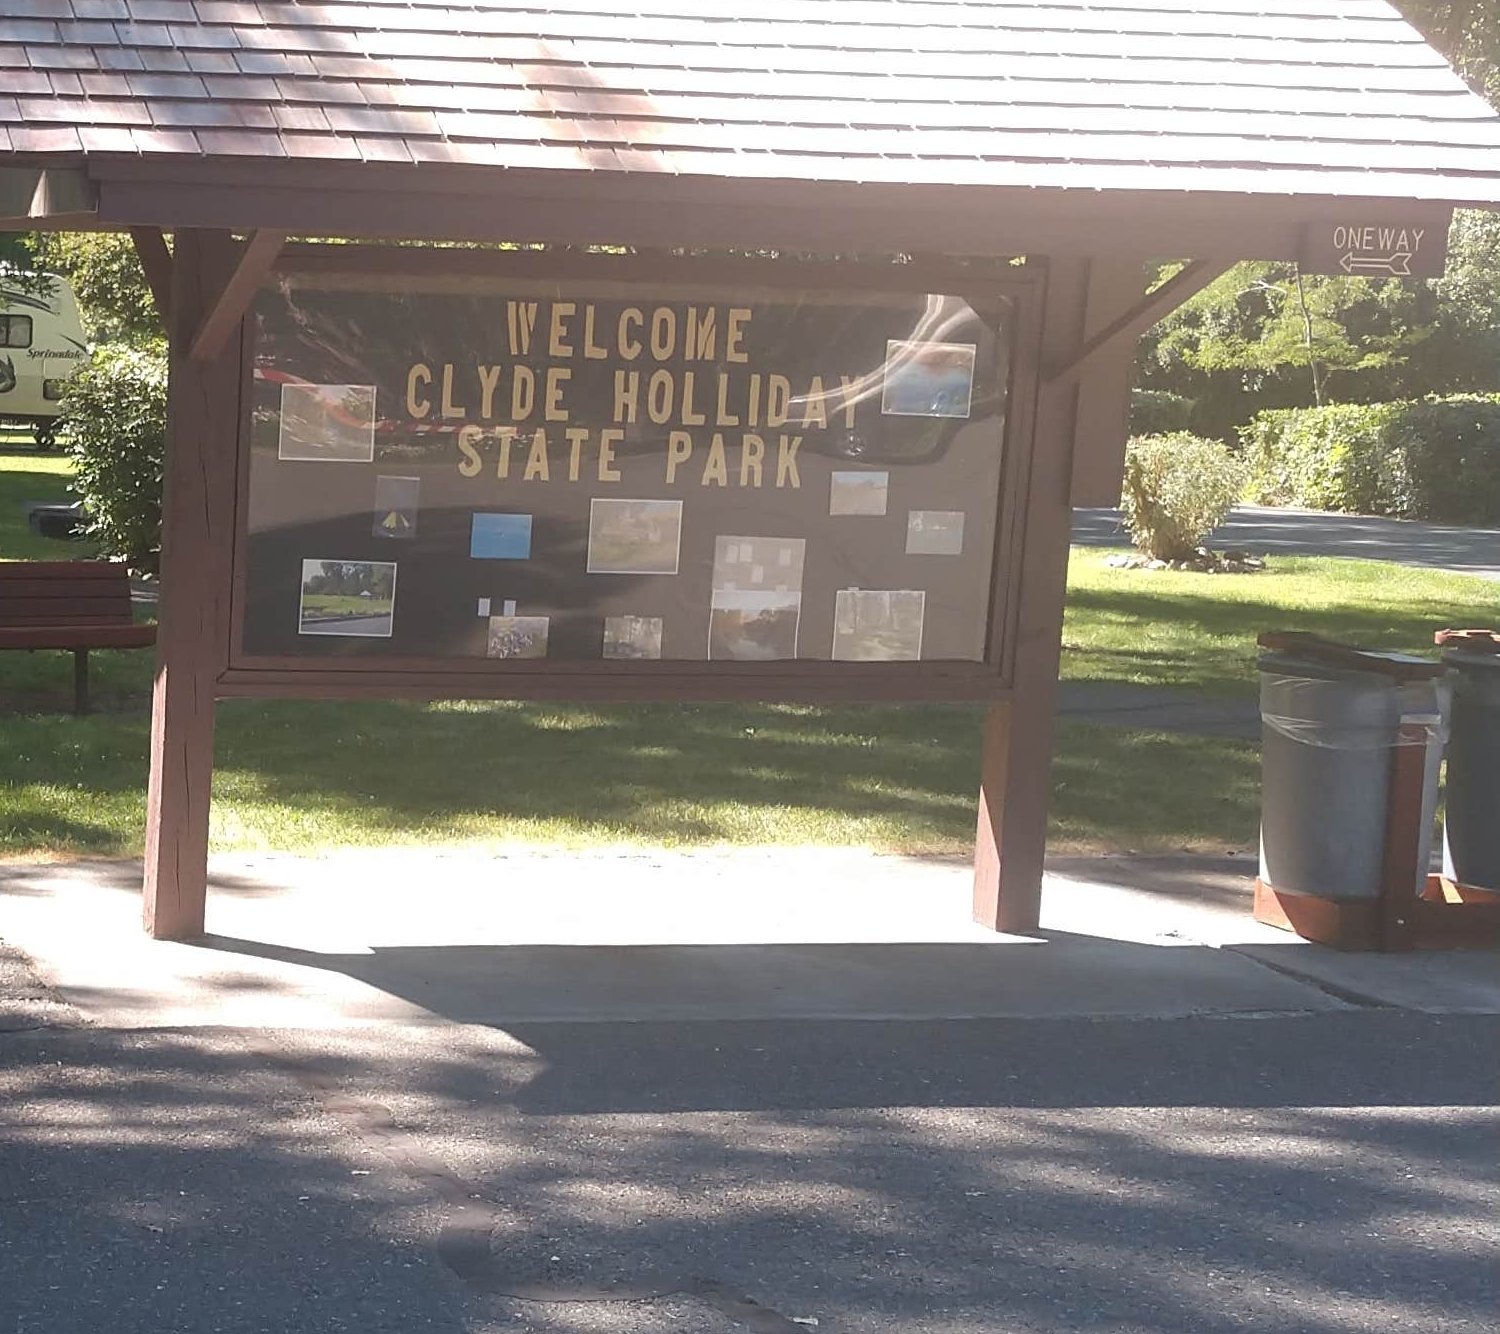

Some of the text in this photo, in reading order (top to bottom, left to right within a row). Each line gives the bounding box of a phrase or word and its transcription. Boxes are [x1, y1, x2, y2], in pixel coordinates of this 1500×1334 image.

[506, 300, 752, 364] WELCOME
[406, 364, 866, 429] CLYDE HOLLIDAY
[457, 424, 803, 489] STATE PARK
